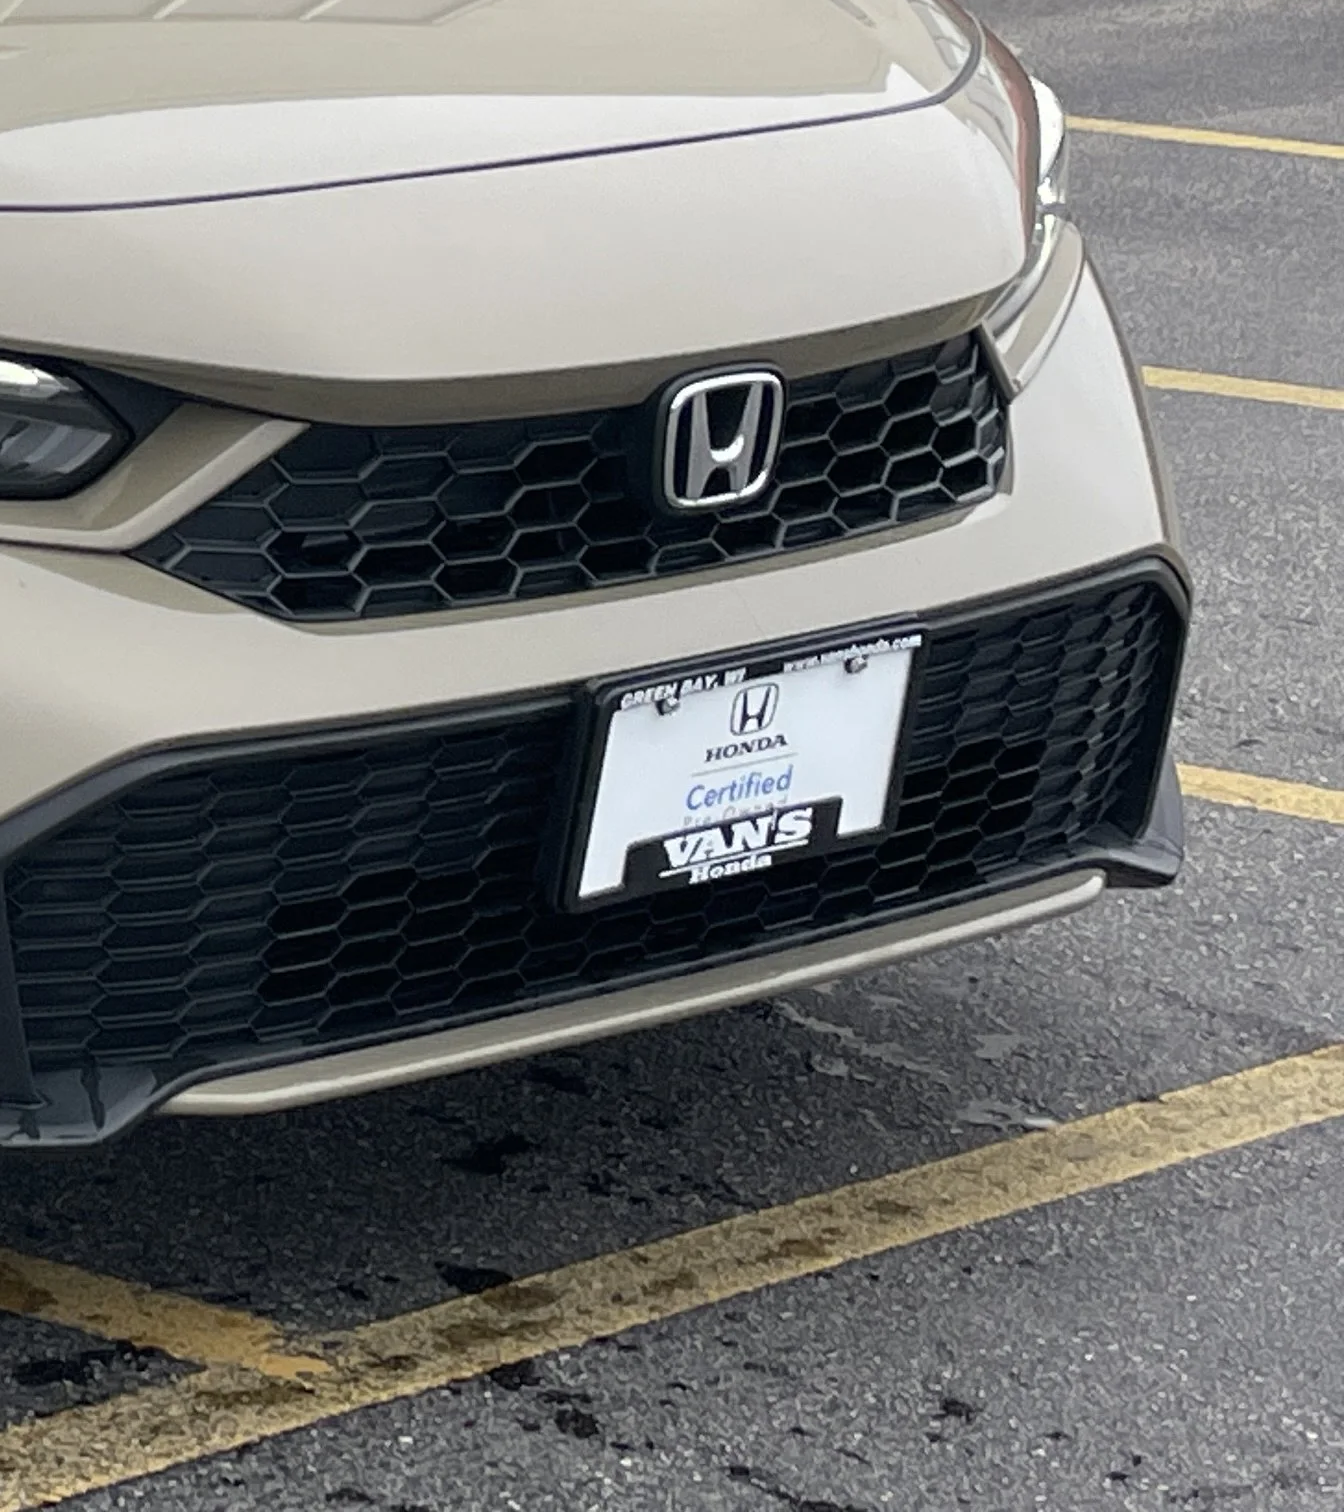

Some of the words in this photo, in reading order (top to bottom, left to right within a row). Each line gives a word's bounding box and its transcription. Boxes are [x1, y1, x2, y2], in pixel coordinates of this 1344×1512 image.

[704, 733, 788, 763] HONDA
[686, 763, 794, 810] Certified
[688, 854, 772, 885] Honda
